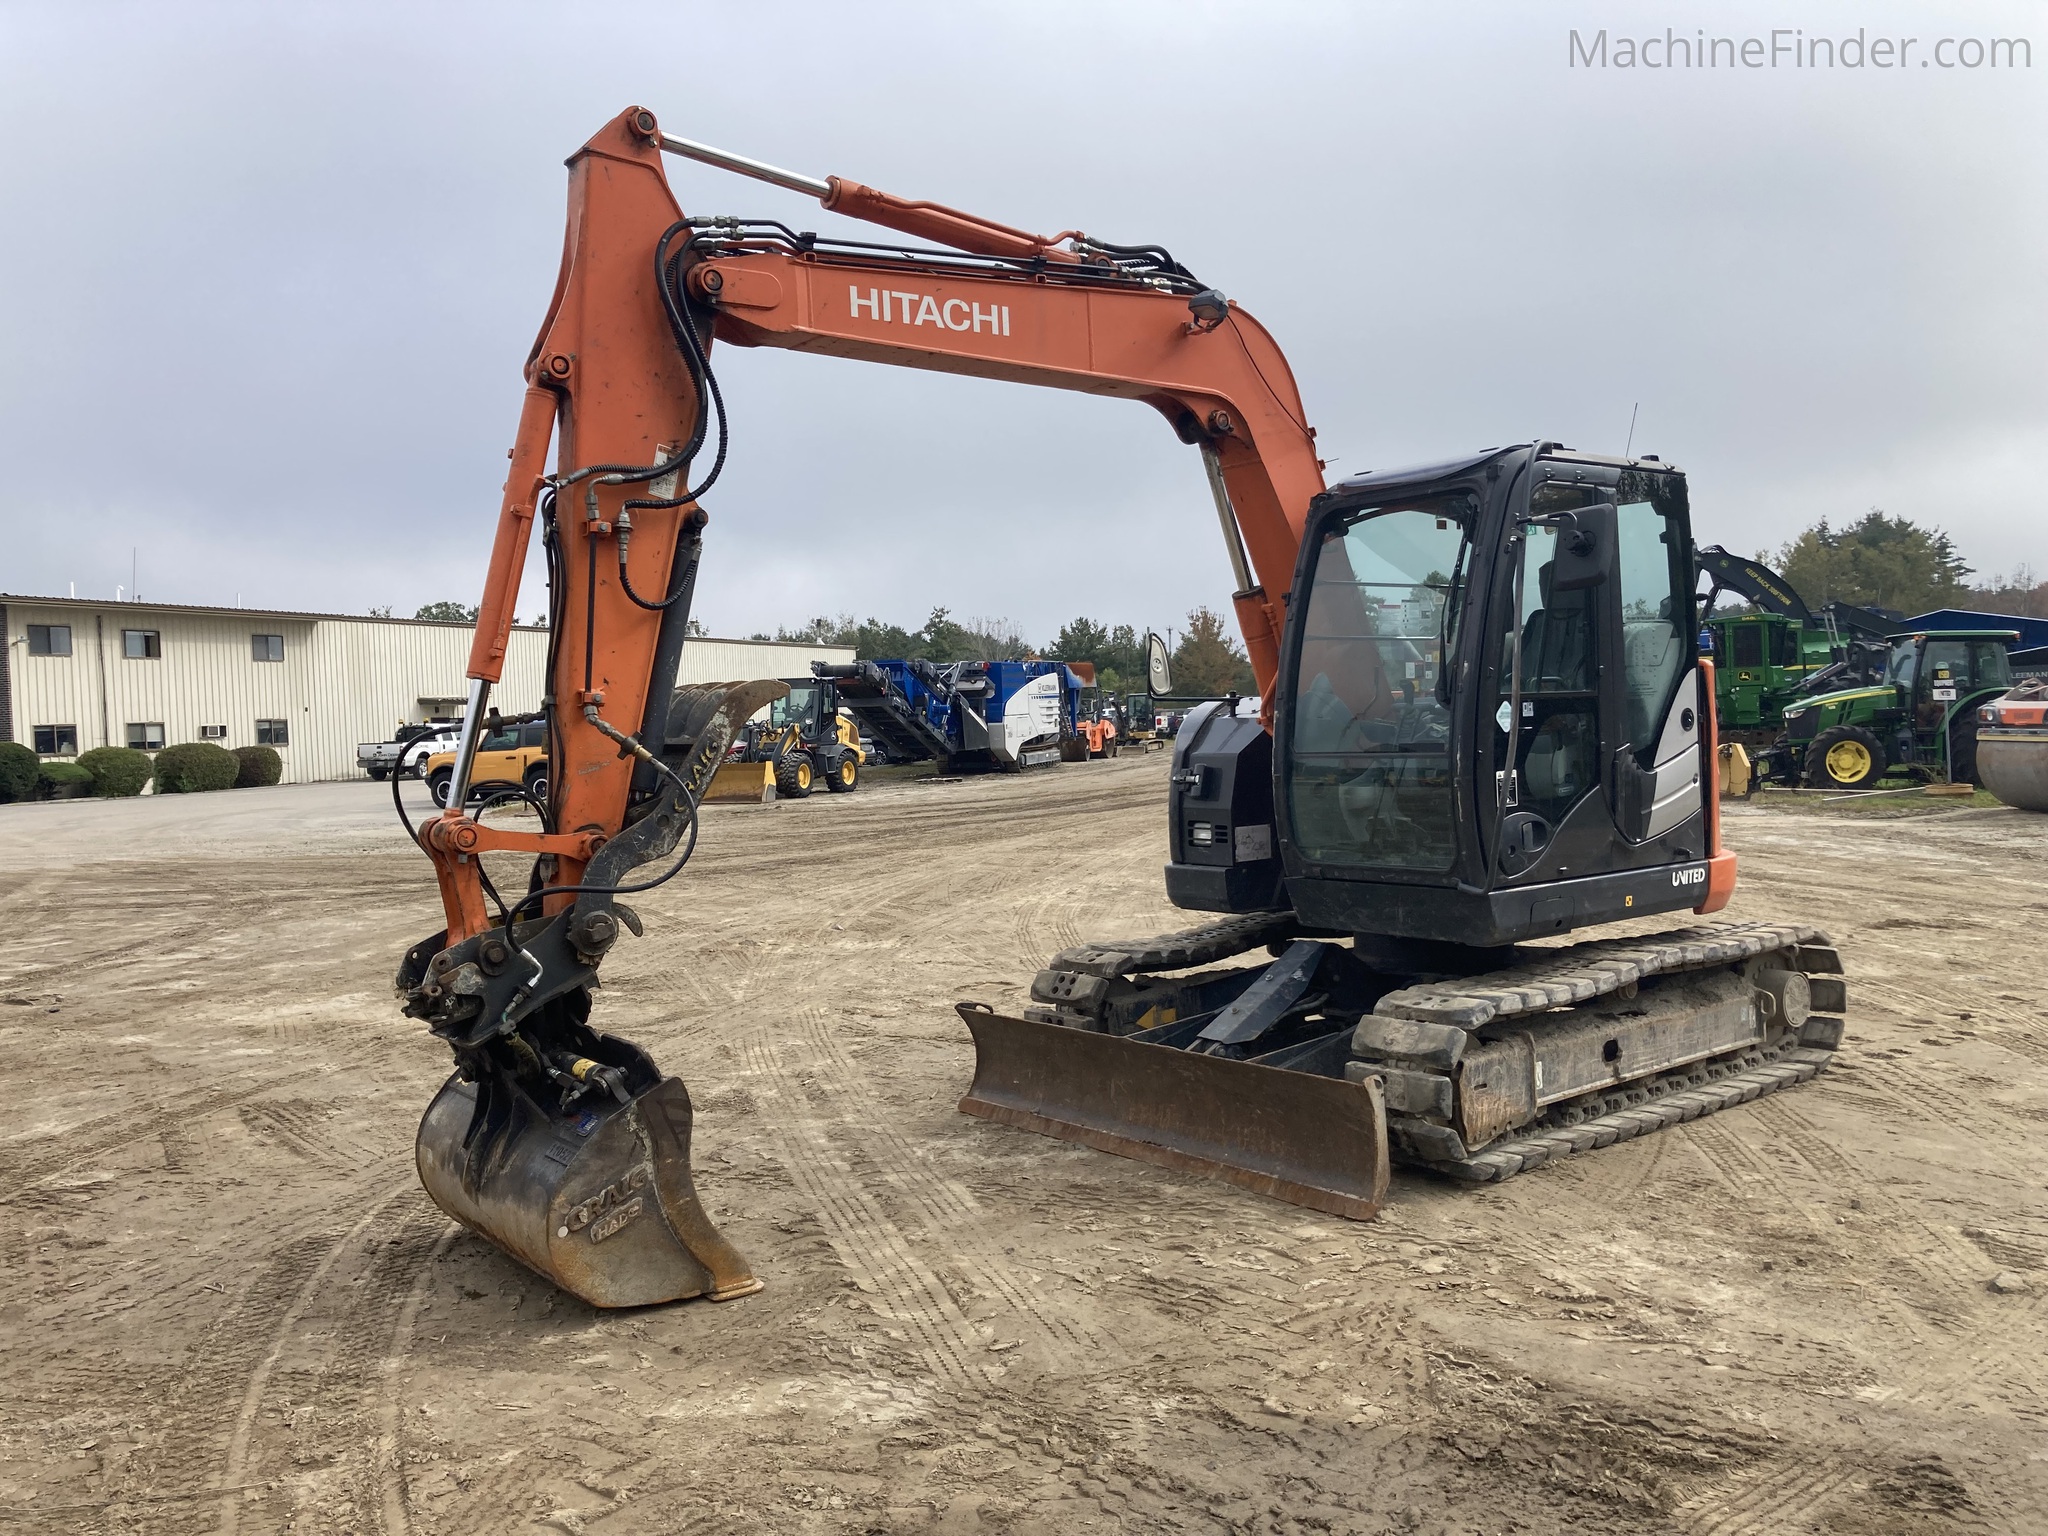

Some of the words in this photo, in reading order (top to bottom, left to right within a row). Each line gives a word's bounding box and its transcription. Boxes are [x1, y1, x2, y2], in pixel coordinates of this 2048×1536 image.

[849, 285, 1010, 337] HITACHI
[1672, 868, 1705, 887] UNITED
[565, 1163, 648, 1231] CRAIG
